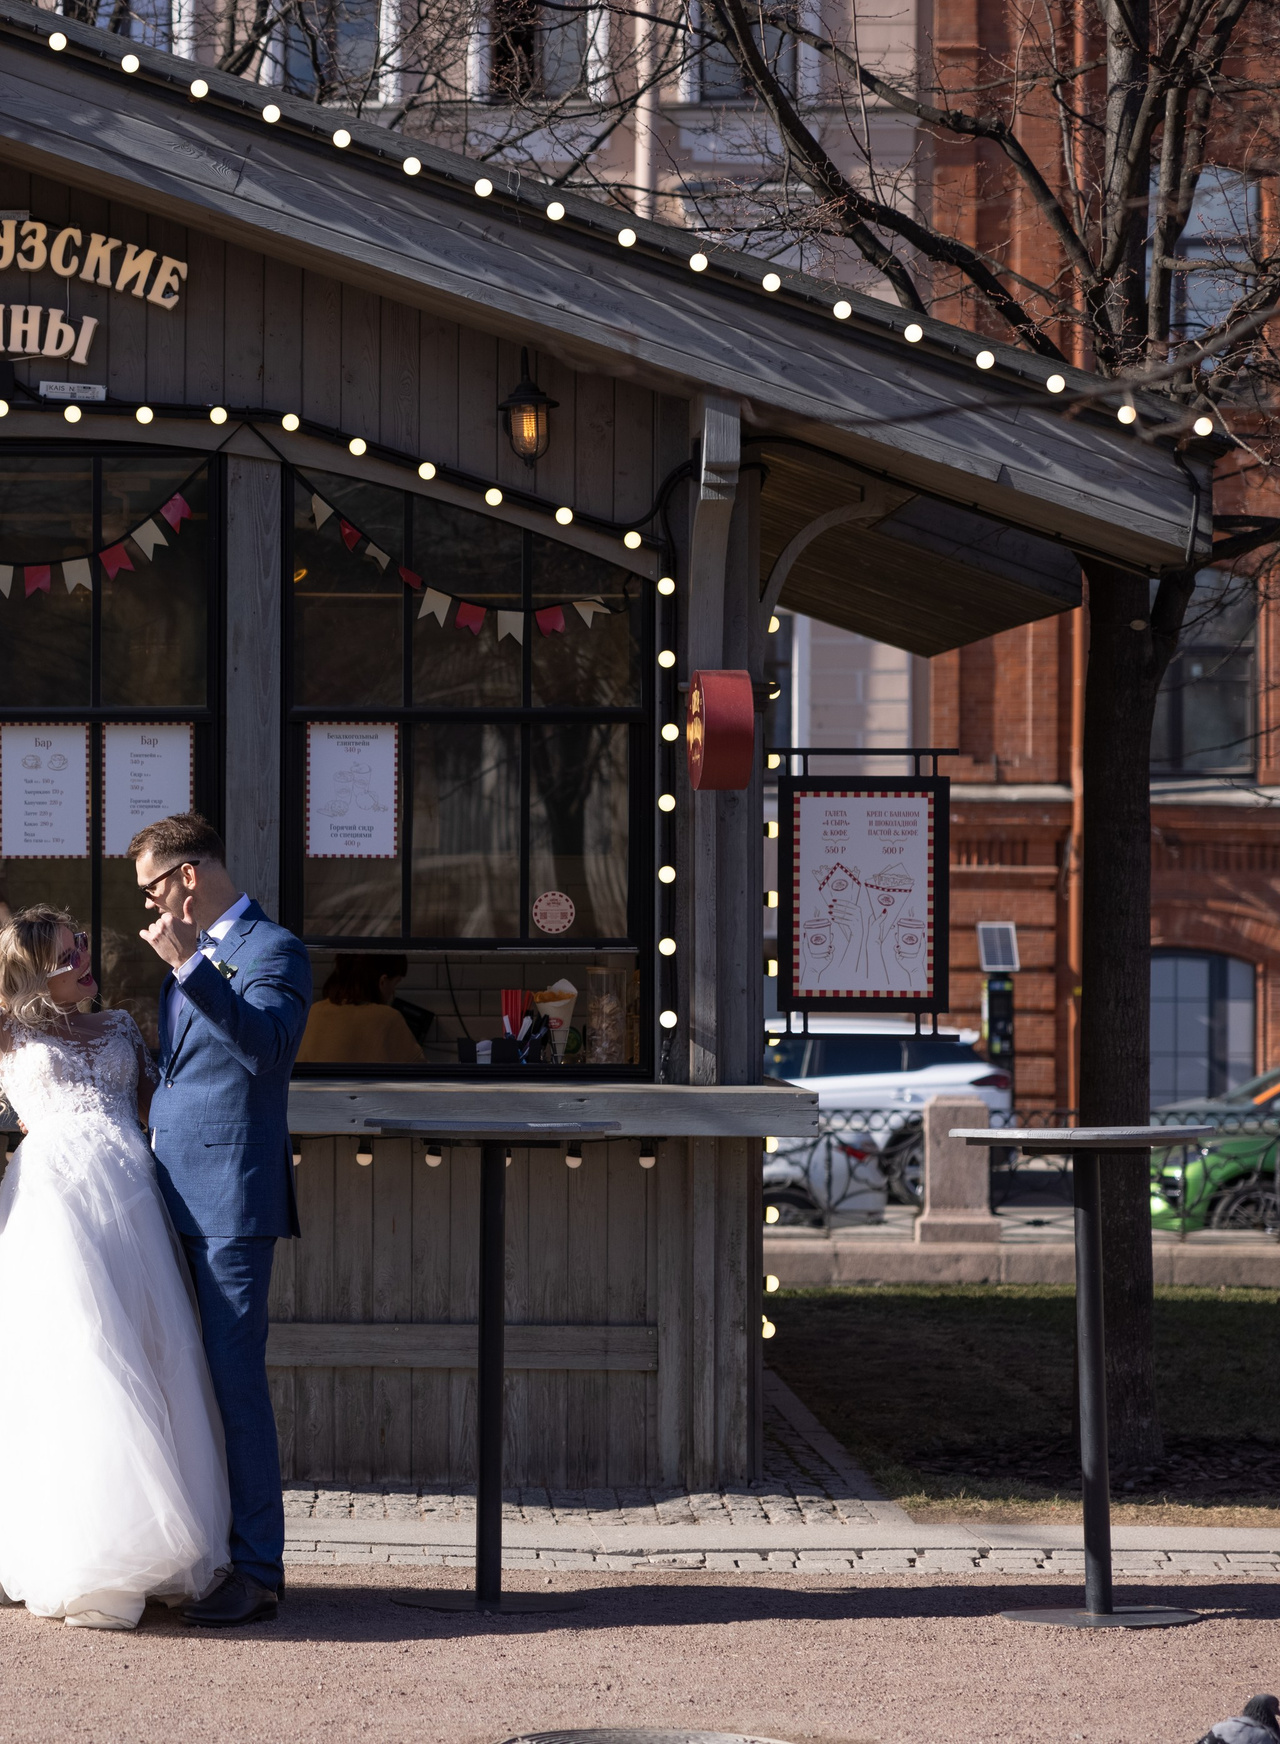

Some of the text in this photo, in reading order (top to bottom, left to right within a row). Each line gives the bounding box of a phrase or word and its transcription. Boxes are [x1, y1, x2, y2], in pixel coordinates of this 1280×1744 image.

[34, 737, 52, 750] Бар
[141, 736, 158, 748] Бар
[874, 819, 918, 828] ШОКОЛАДНОЙ
[825, 846, 839, 854] 550
